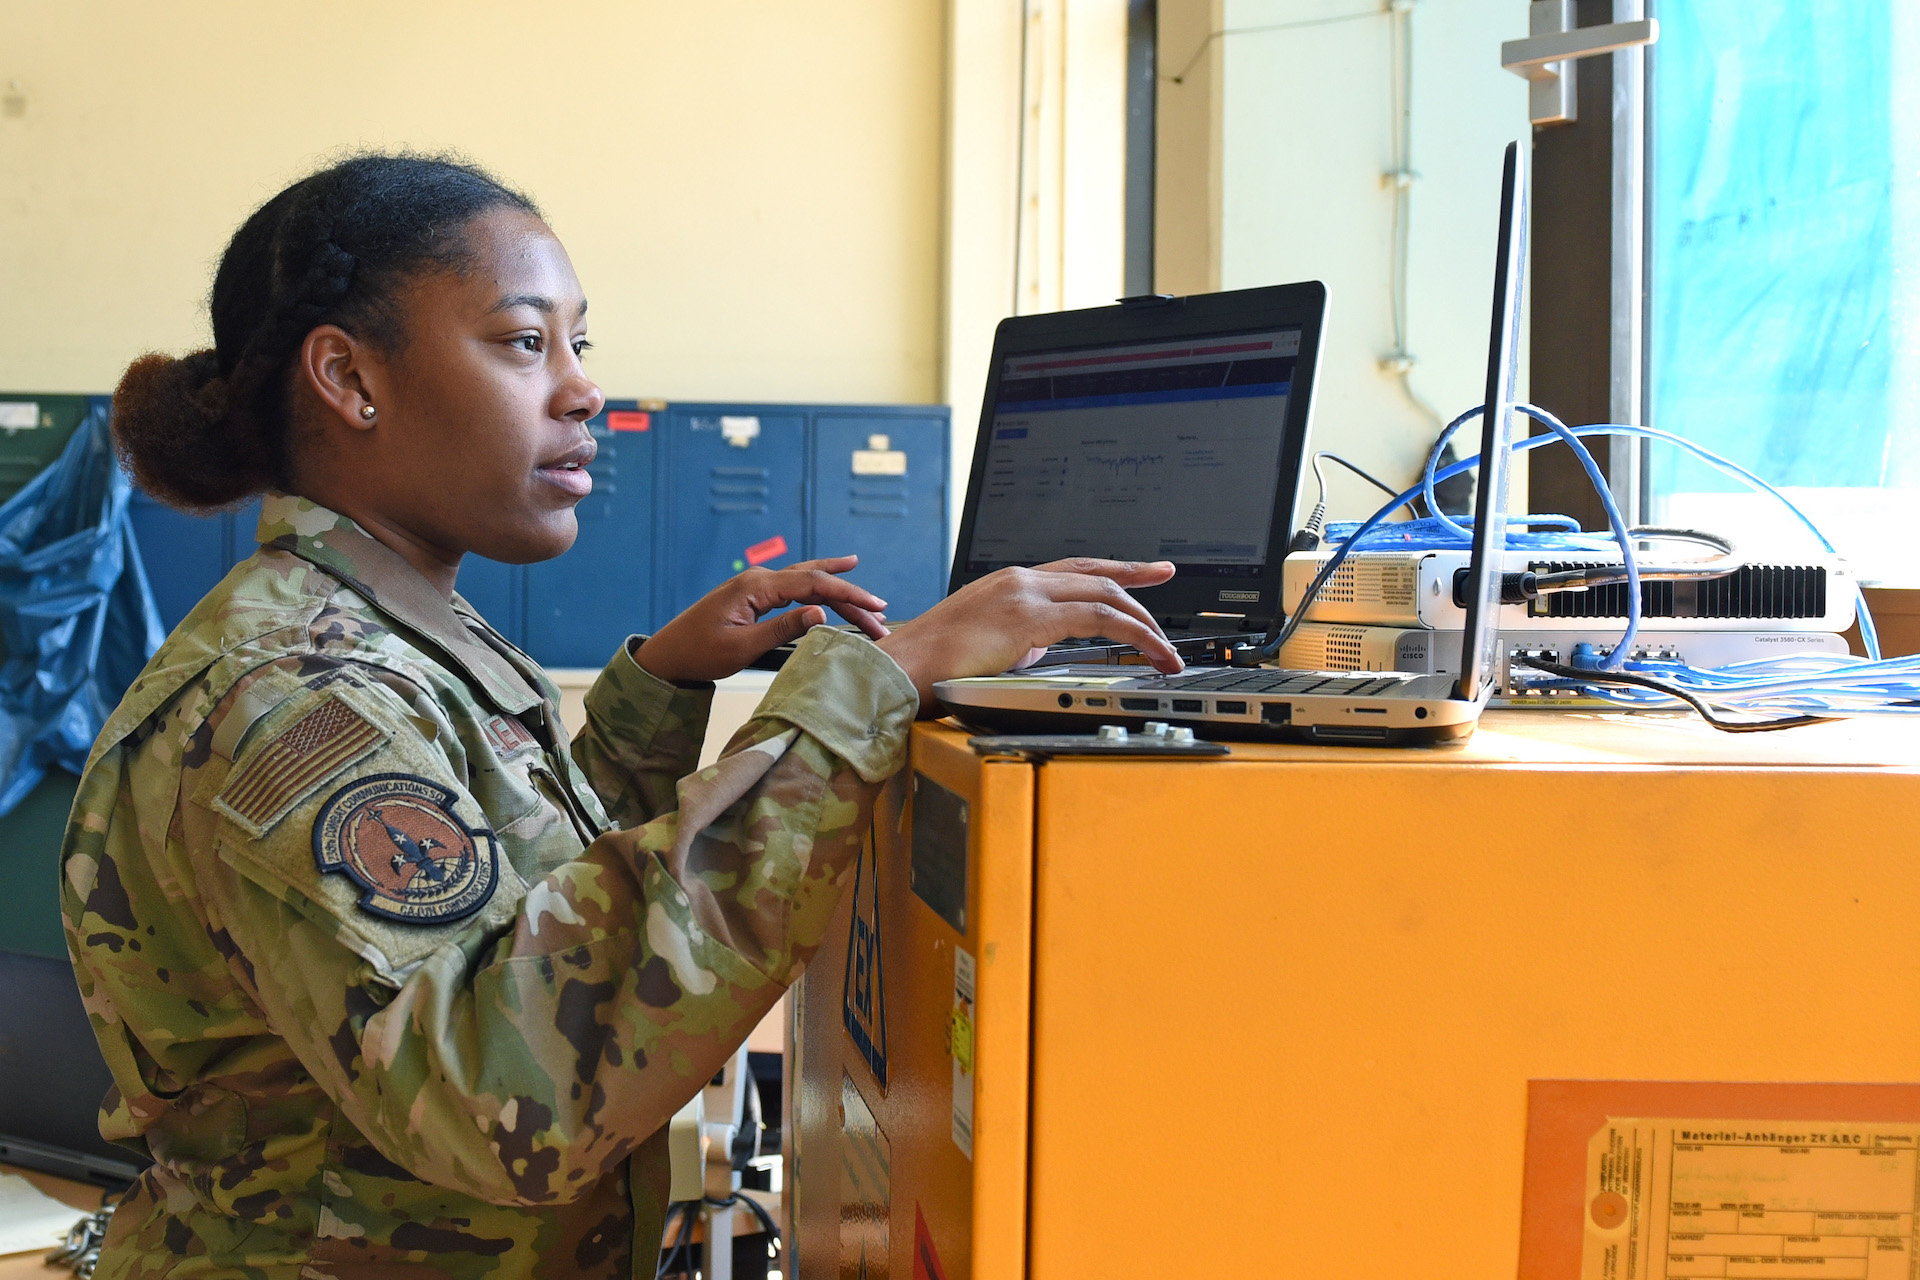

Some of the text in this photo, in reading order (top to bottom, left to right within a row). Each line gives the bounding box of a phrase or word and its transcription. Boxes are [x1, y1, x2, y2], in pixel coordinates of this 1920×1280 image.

[1754, 636, 1779, 644] Catalyst
[325, 807, 347, 839] COMBAT
[343, 781, 429, 811] COMMUNICATIONS
[428, 788, 445, 804] SQ
[399, 859, 492, 918] CAJUN COMMUNICATORS
[1682, 1131, 1807, 1145] Material-Anhänger
[1810, 1133, 1828, 1143] ZK
